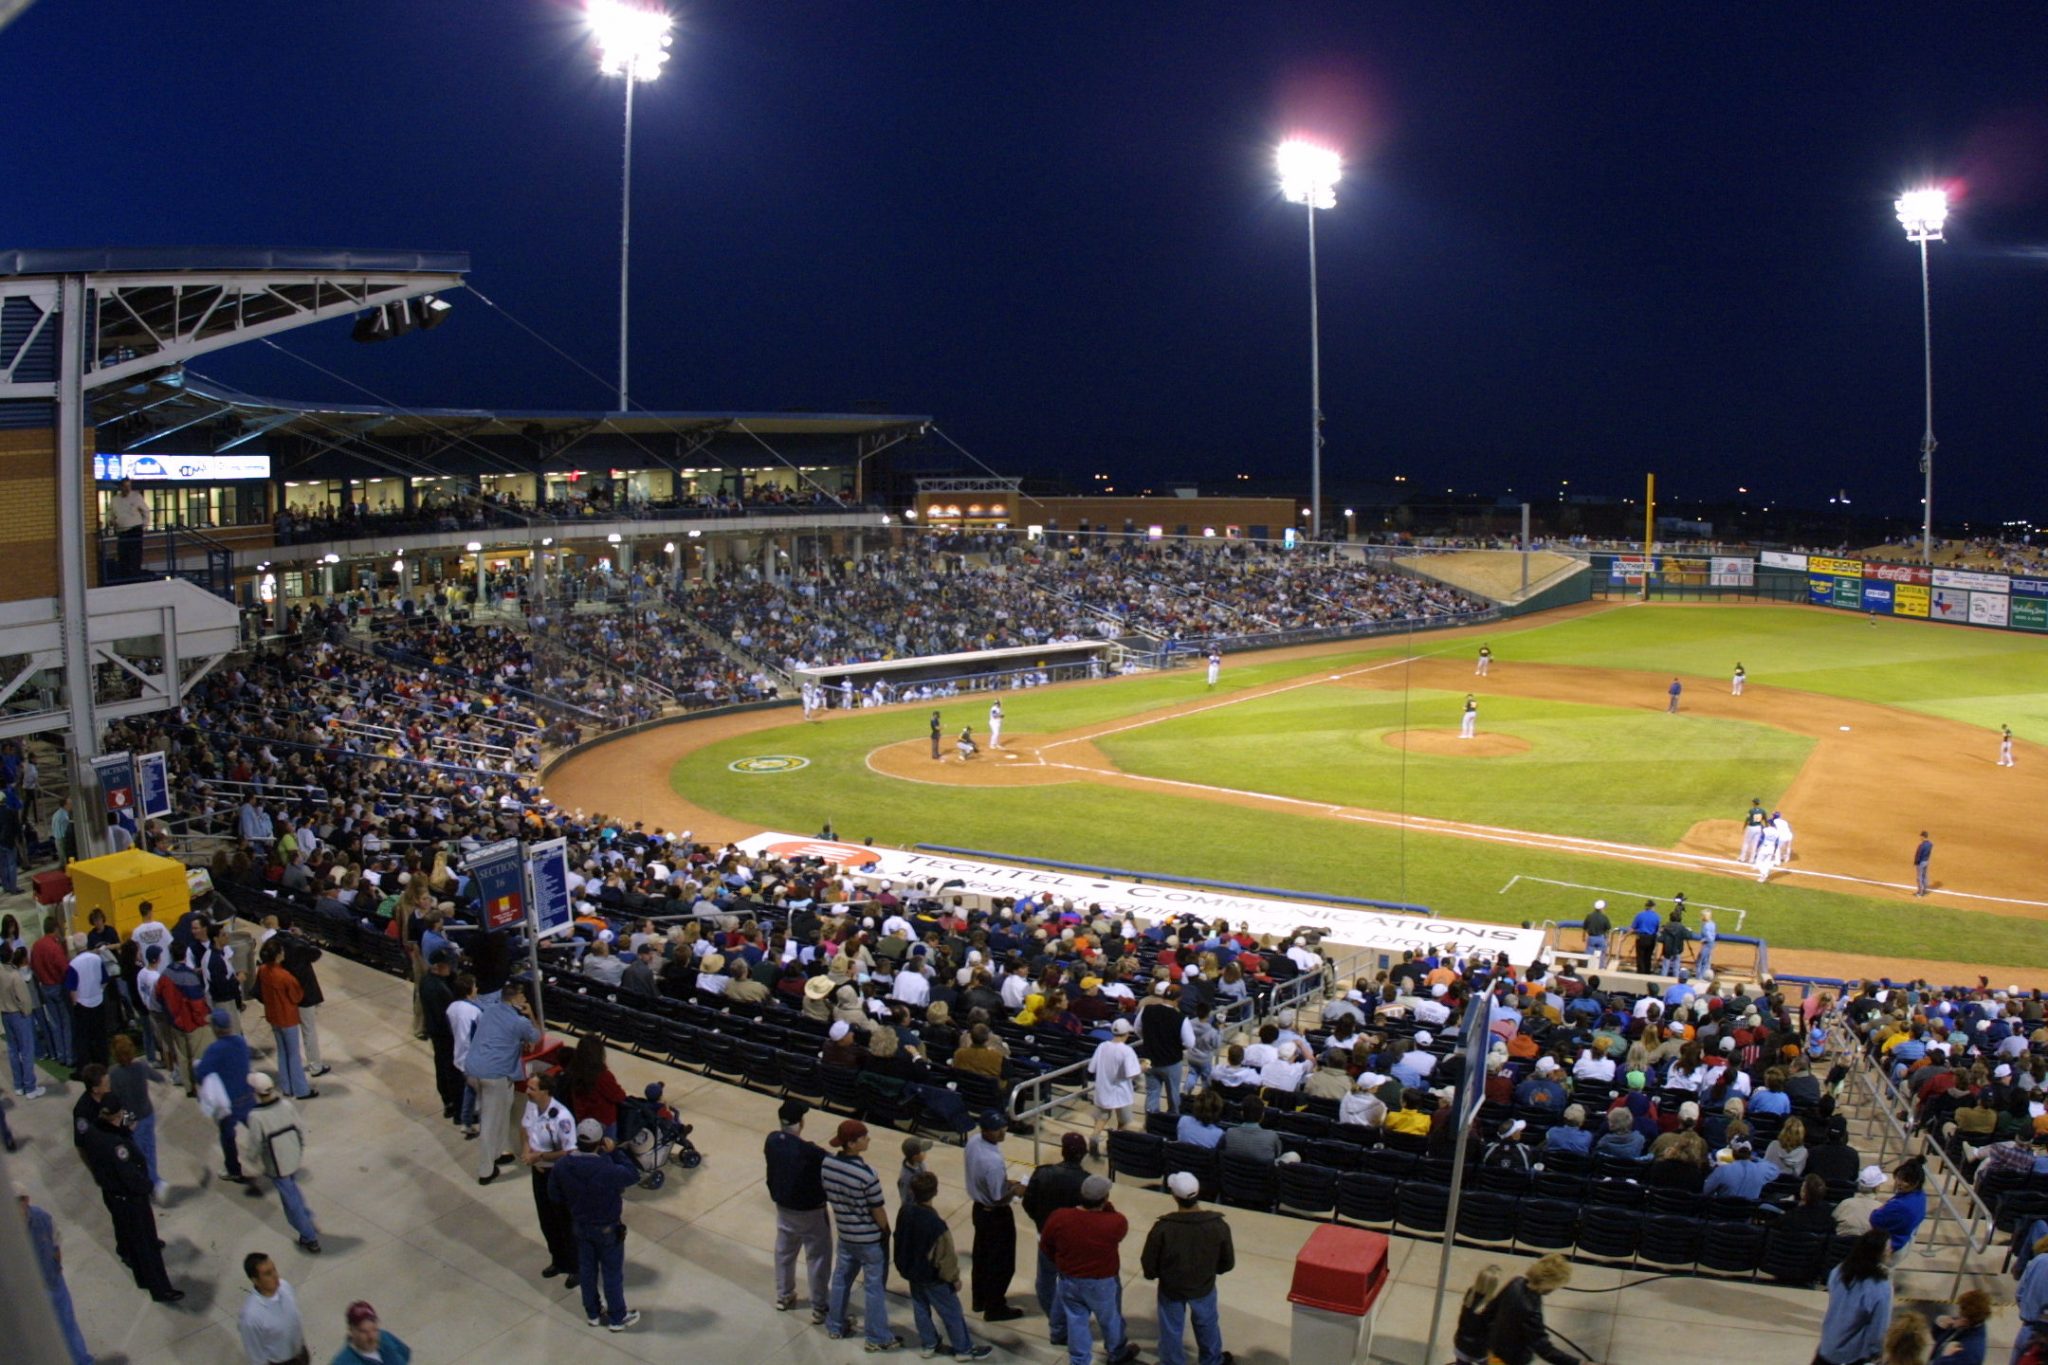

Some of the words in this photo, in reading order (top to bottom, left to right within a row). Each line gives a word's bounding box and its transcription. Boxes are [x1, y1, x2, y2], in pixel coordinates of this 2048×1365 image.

[1877, 565, 1913, 582] Coca-Cola
[480, 861, 518, 879] SECTION
[907, 854, 1072, 888] TECHTEL
[1127, 886, 1519, 941] COMMUNICATIONS
